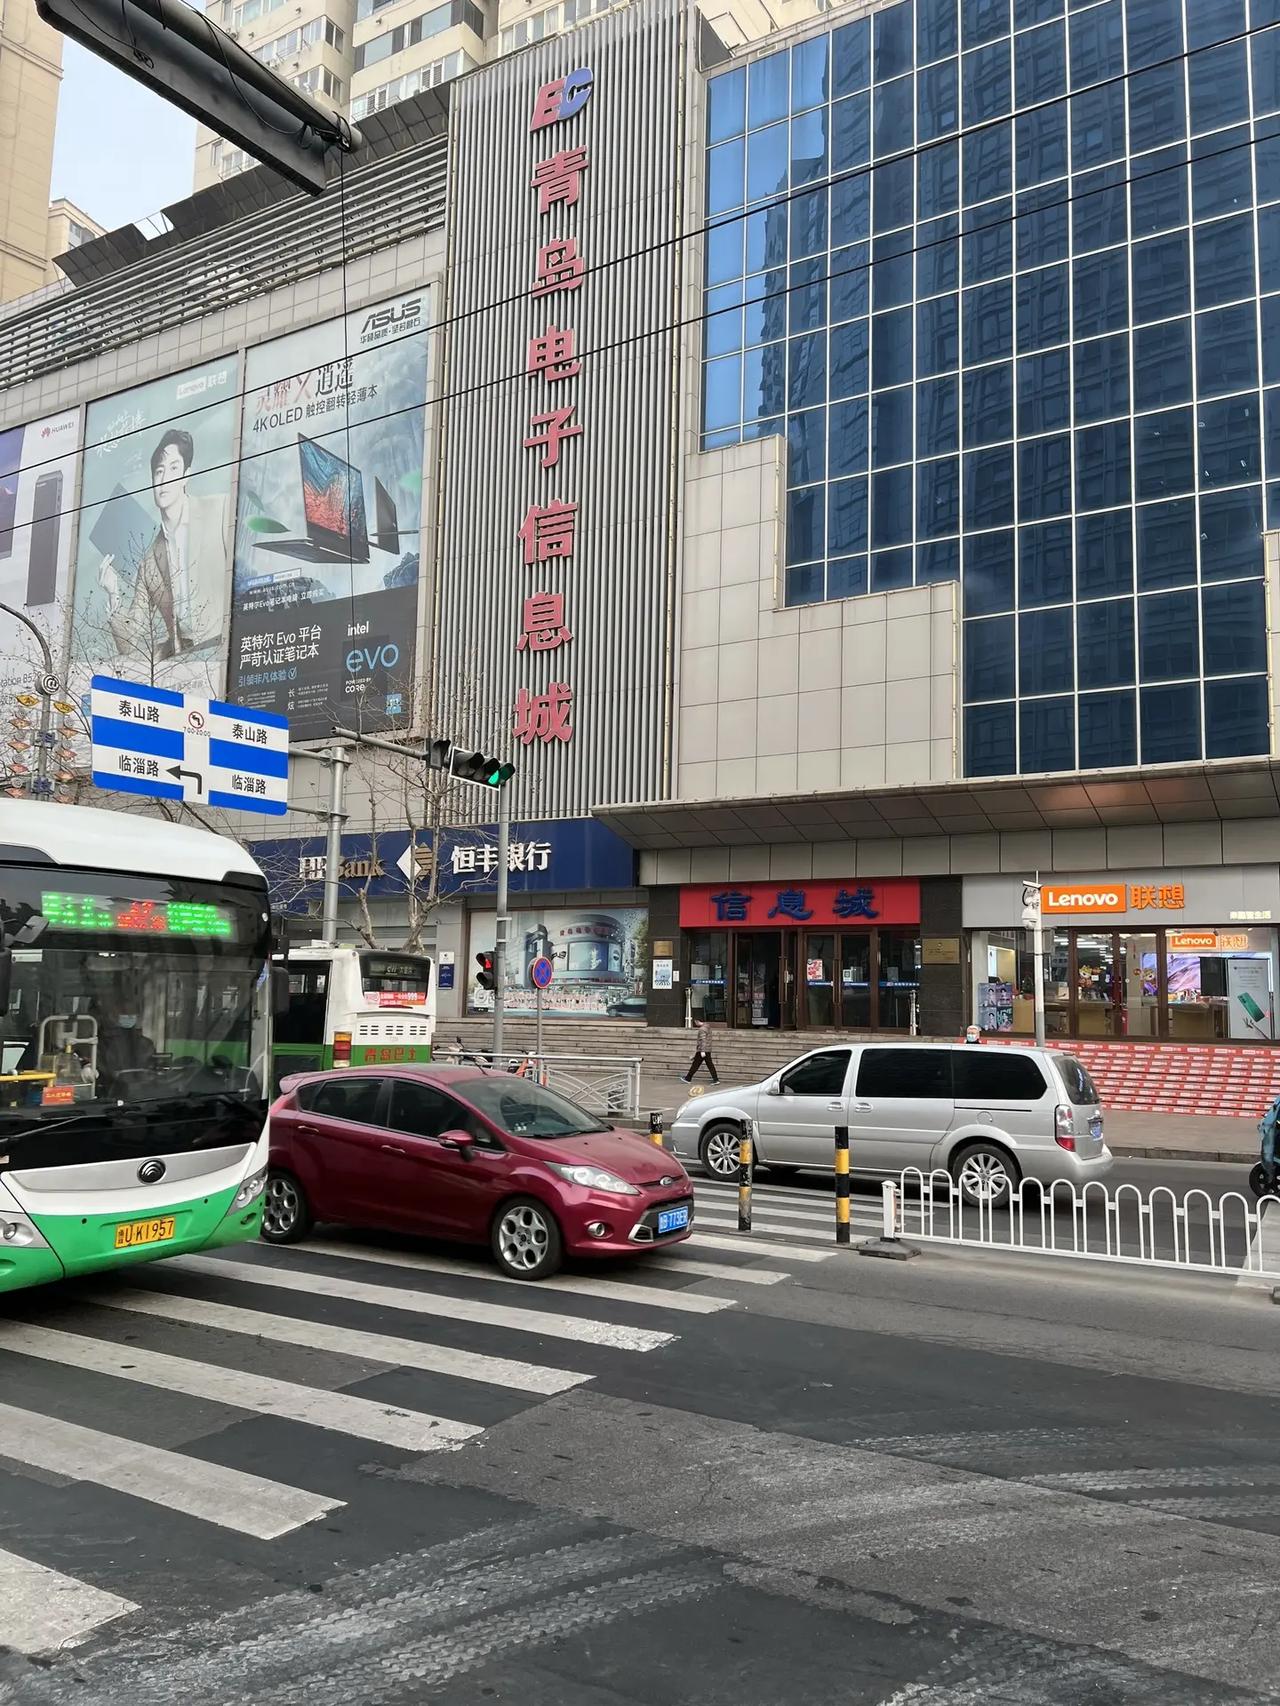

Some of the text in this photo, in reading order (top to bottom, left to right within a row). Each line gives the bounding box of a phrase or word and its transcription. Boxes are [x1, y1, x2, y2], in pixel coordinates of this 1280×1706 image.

[361, 298, 421, 334] ASUS
[305, 384, 378, 418] 触控翻转轻薄本
[51, 421, 75, 434] HUAWEI
[512, 145, 589, 744] 青岛电子信息城
[241, 624, 322, 652] 英特尔 Evo 平台
[347, 621, 370, 636] intel
[239, 643, 320, 670] 严苛认证笔记本
[346, 643, 399, 673] evo
[238, 669, 287, 687] 引领非凡体验
[119, 700, 160, 723] 泰山路
[232, 723, 268, 745] 泰山路
[118, 754, 159, 778] 临淄路
[231, 774, 267, 795] 临淄路
[451, 841, 552, 874] 恒丰银行
[711, 887, 878, 921] 信息城
[1049, 891, 1118, 906] Lenovo
[1130, 884, 1184, 909] 联想
[1175, 936, 1213, 946] Lenovo
[1221, 935, 1247, 949] 联想
[364, 1046, 417, 1062] 青岛巴士
